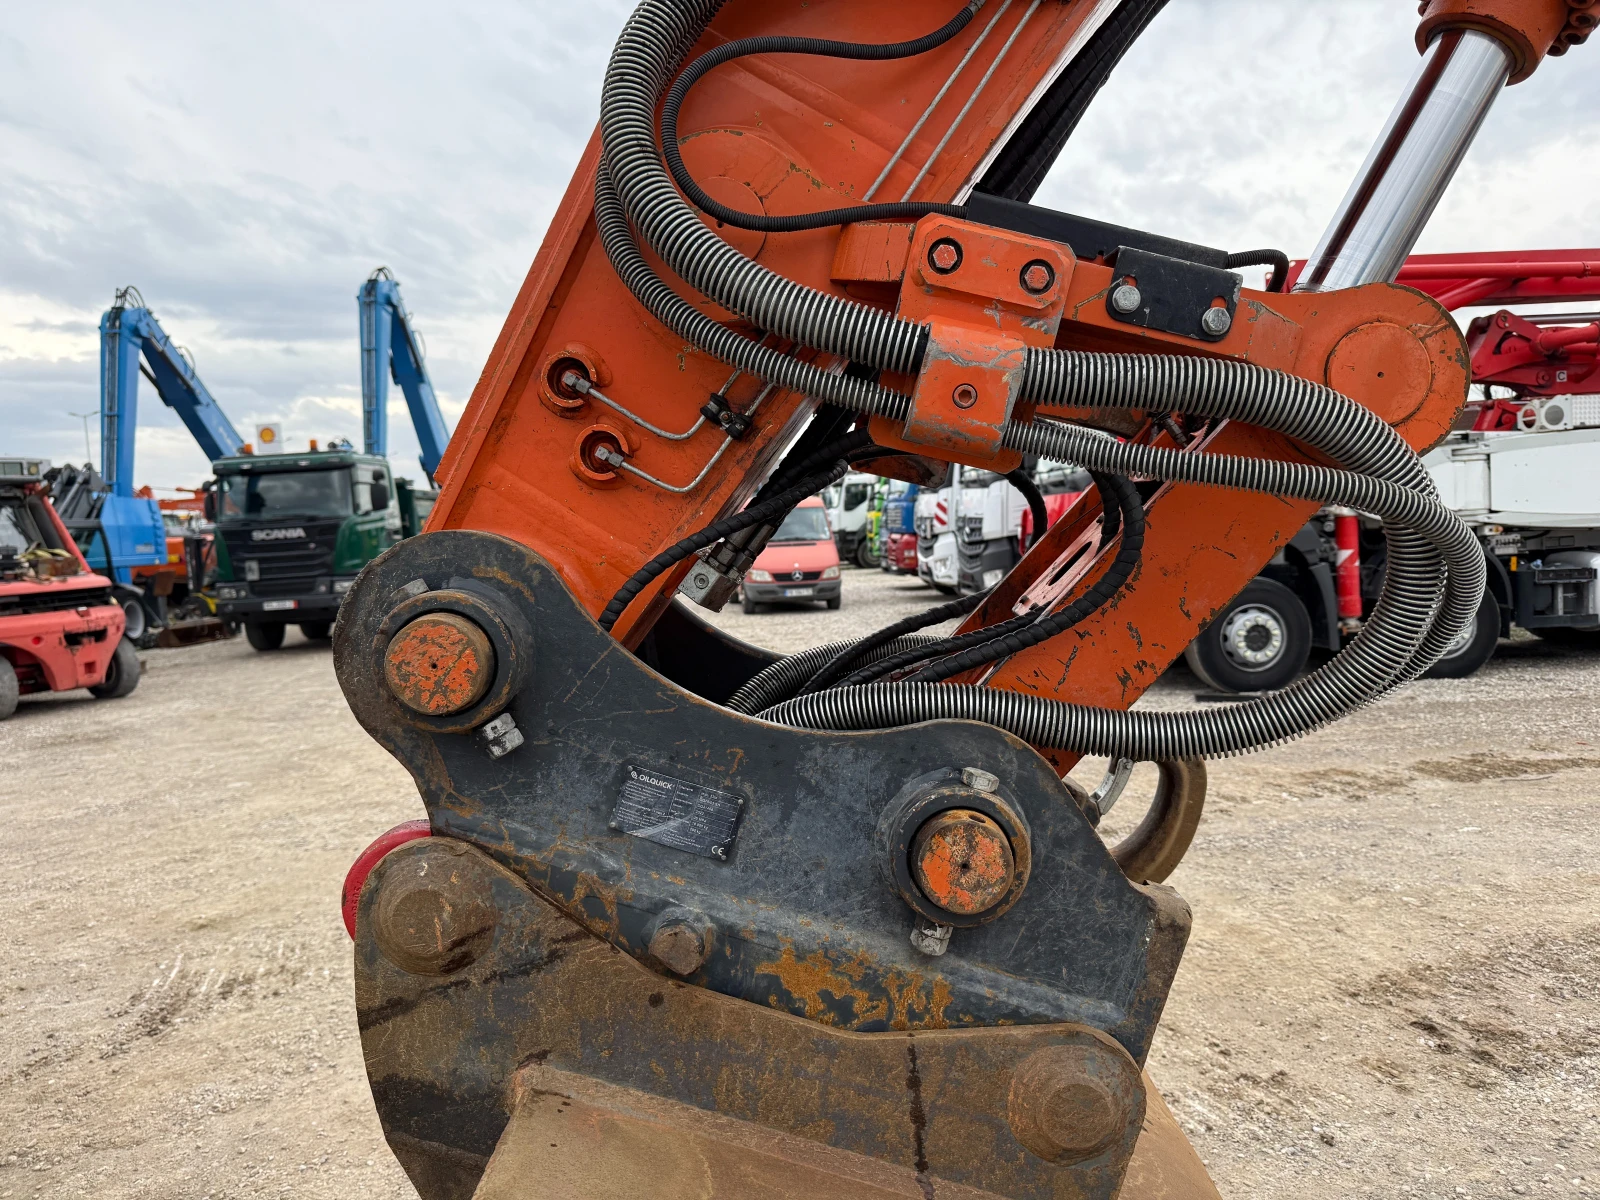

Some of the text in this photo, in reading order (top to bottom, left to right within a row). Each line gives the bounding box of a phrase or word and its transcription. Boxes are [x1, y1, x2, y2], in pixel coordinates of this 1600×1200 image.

[1558, 372, 1566, 380] C
[251, 527, 307, 541] SCANIA
[639, 774, 673, 790] OILQUICK
